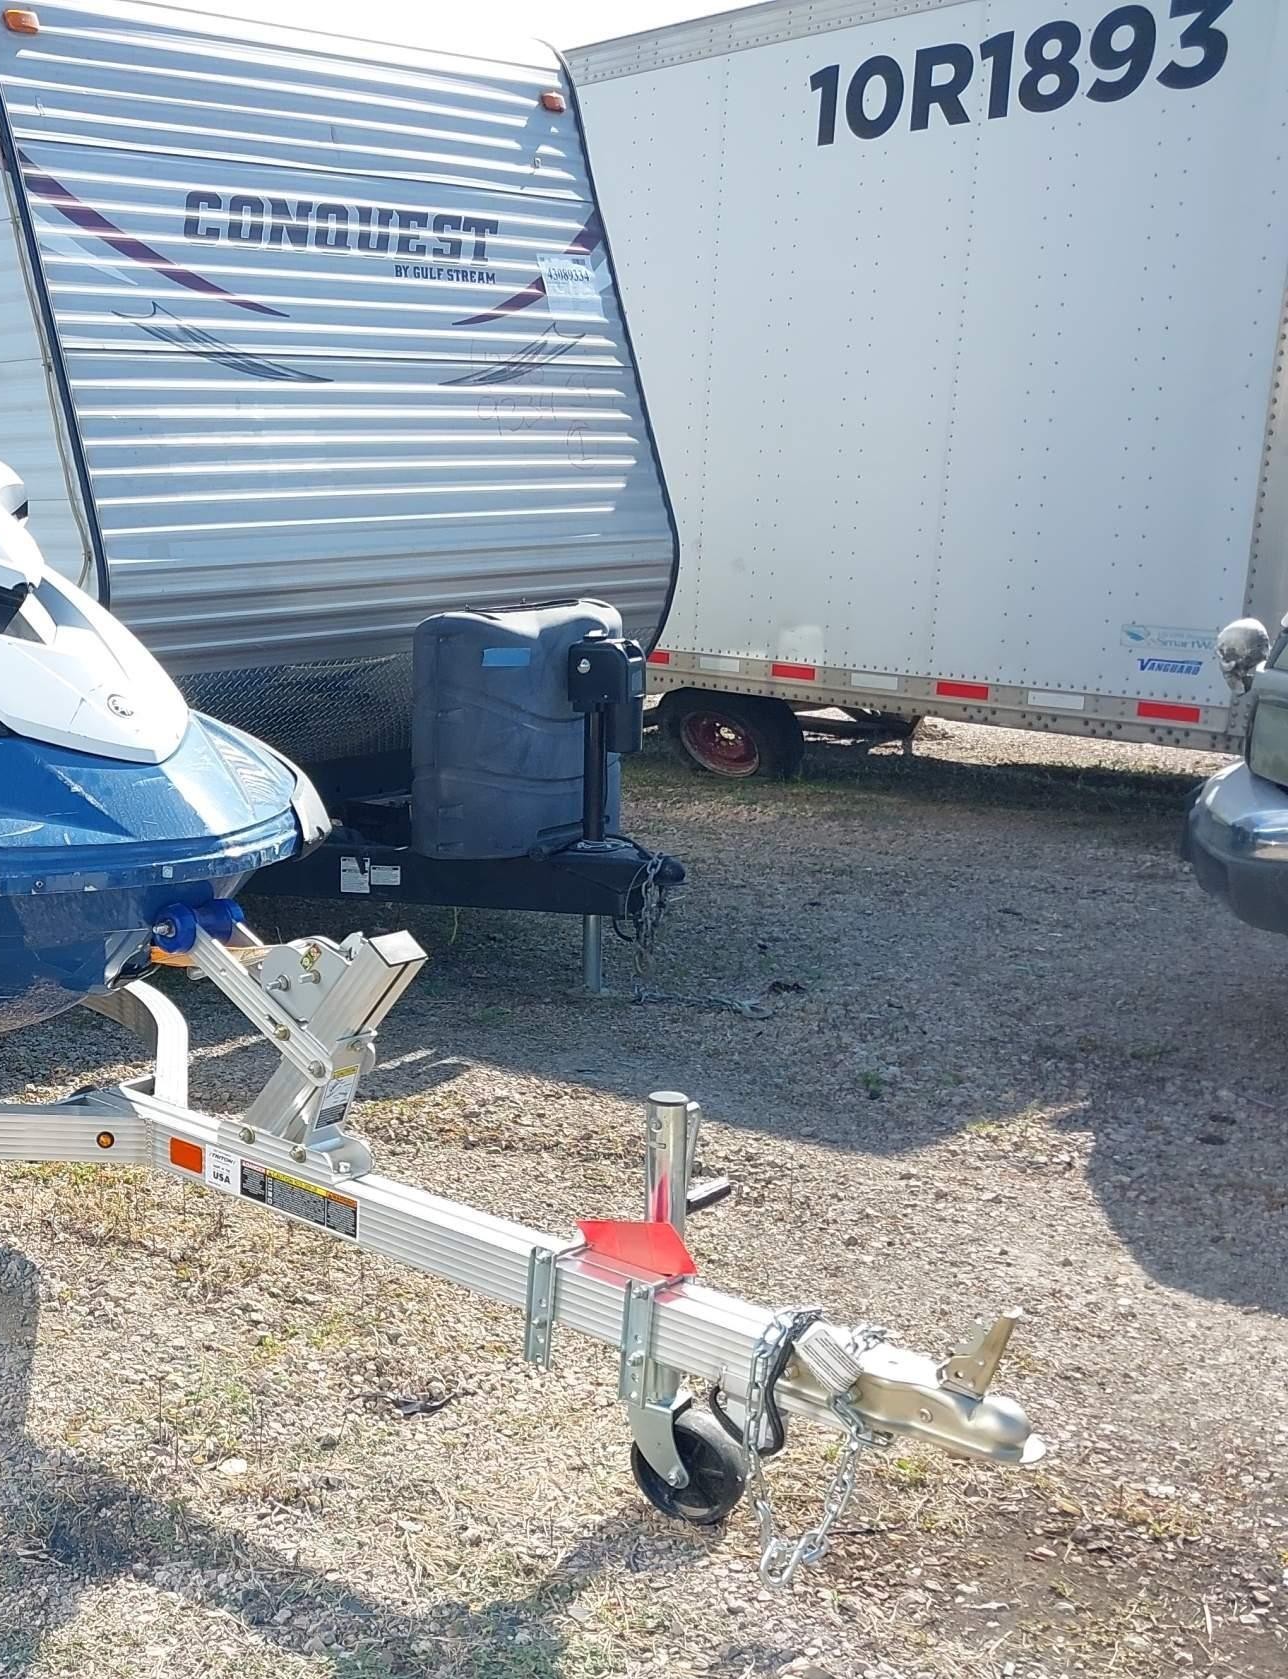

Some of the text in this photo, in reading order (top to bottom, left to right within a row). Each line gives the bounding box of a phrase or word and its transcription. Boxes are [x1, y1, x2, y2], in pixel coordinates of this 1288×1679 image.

[809, 0, 1234, 147] 10R1893
[184, 191, 499, 266] CONQUEST
[394, 264, 496, 285] BY GULF STREAM
[547, 266, 590, 282] 43089334
[1137, 658, 1203, 676] VANGUARD
[213, 1171, 231, 1185] USA
